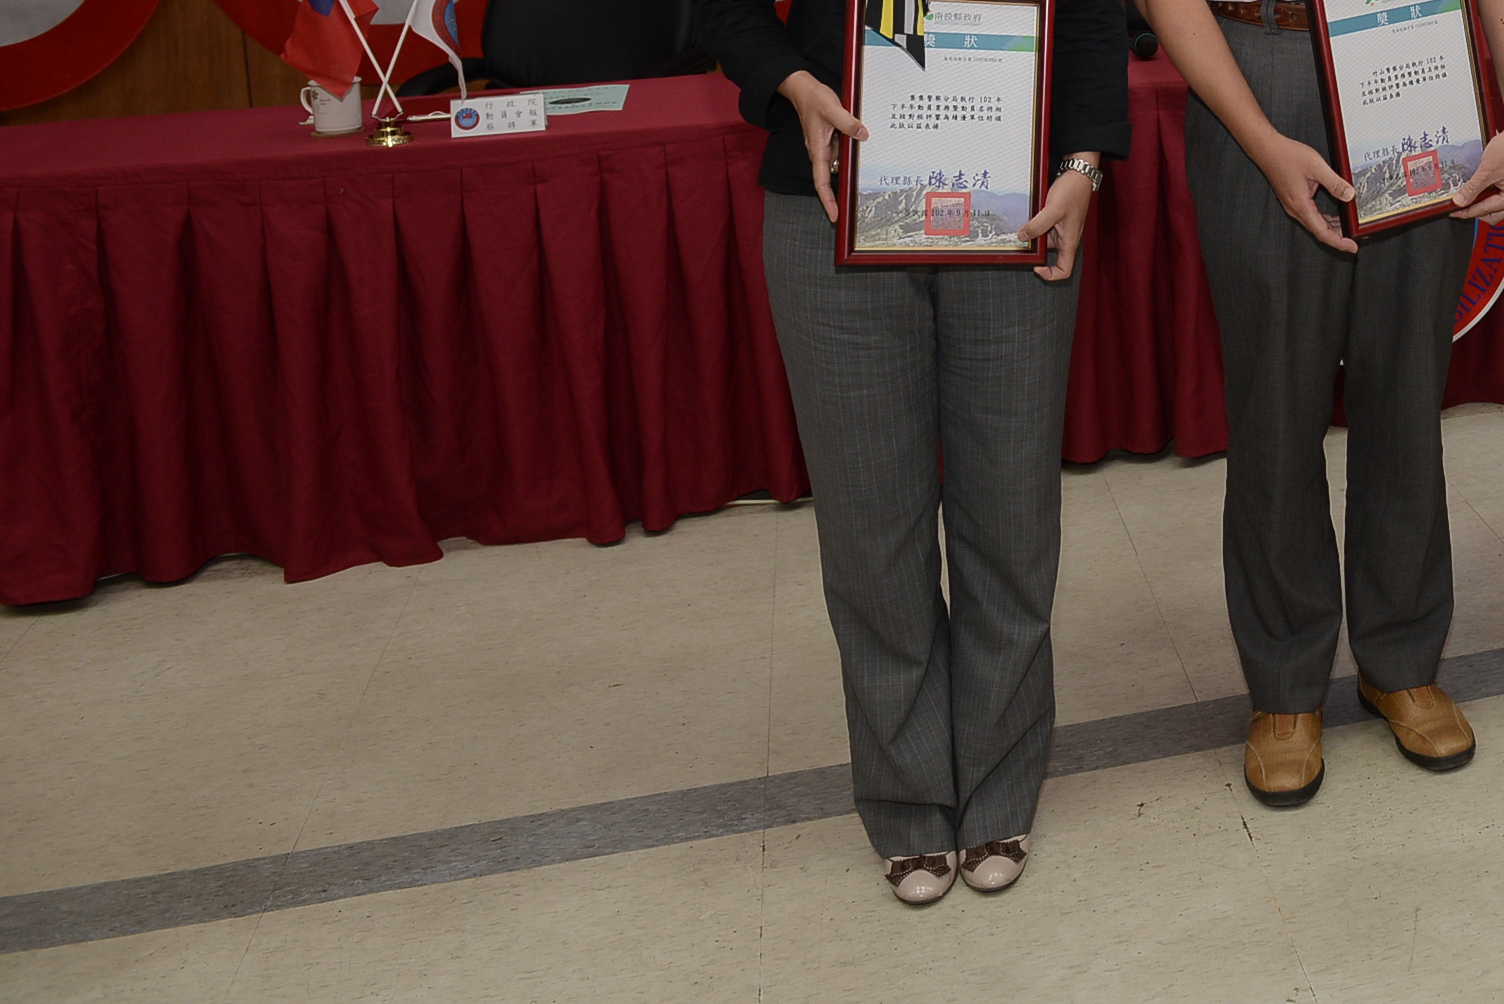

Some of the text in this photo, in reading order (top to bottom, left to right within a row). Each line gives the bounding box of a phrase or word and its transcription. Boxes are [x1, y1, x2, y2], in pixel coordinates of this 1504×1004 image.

[934, 11, 983, 23] 南投縣政府
[485, 97, 538, 110] 行政院
[927, 169, 991, 190] 陳志清
